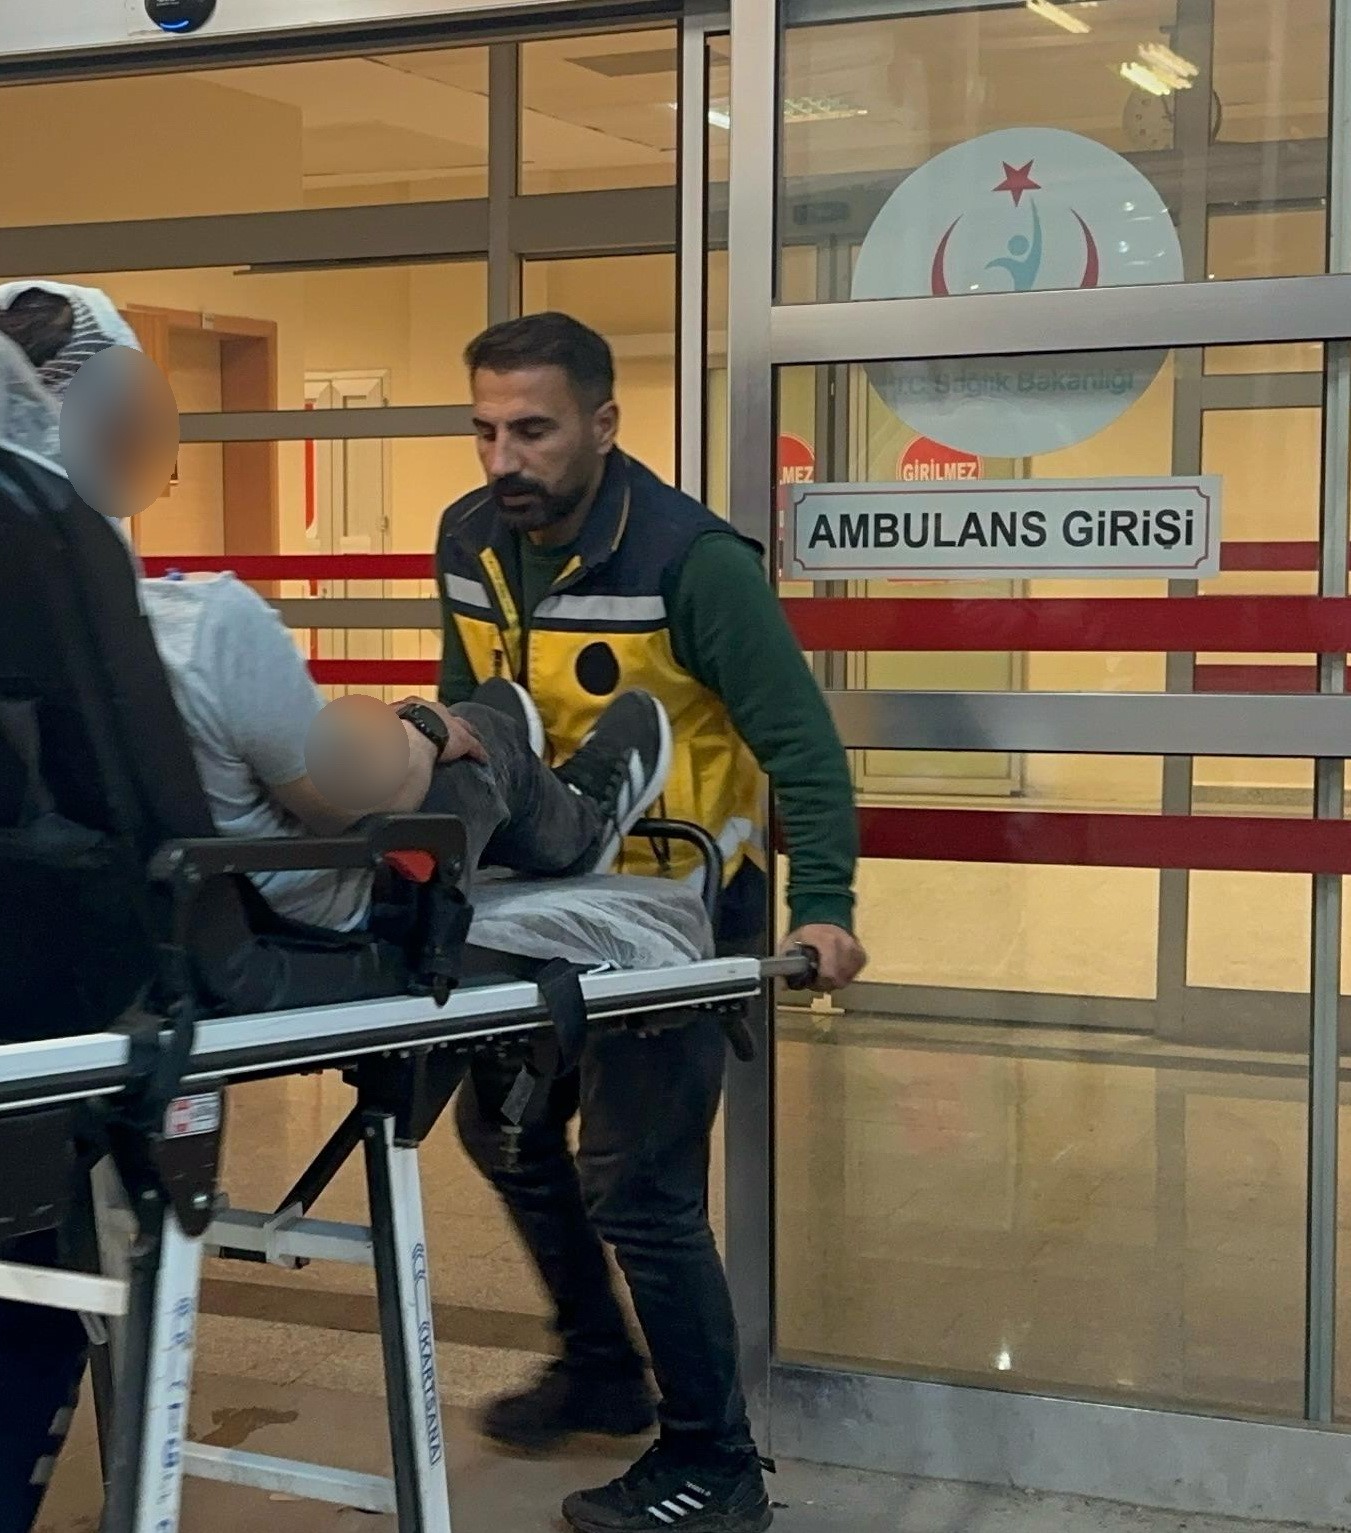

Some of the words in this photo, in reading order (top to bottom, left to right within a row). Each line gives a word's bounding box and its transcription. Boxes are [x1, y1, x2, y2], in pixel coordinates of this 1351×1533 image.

[779, 465, 815, 485] MEZ
[903, 459, 977, 481] GİRİLMEZ
[808, 511, 1047, 549] AMBULANS
